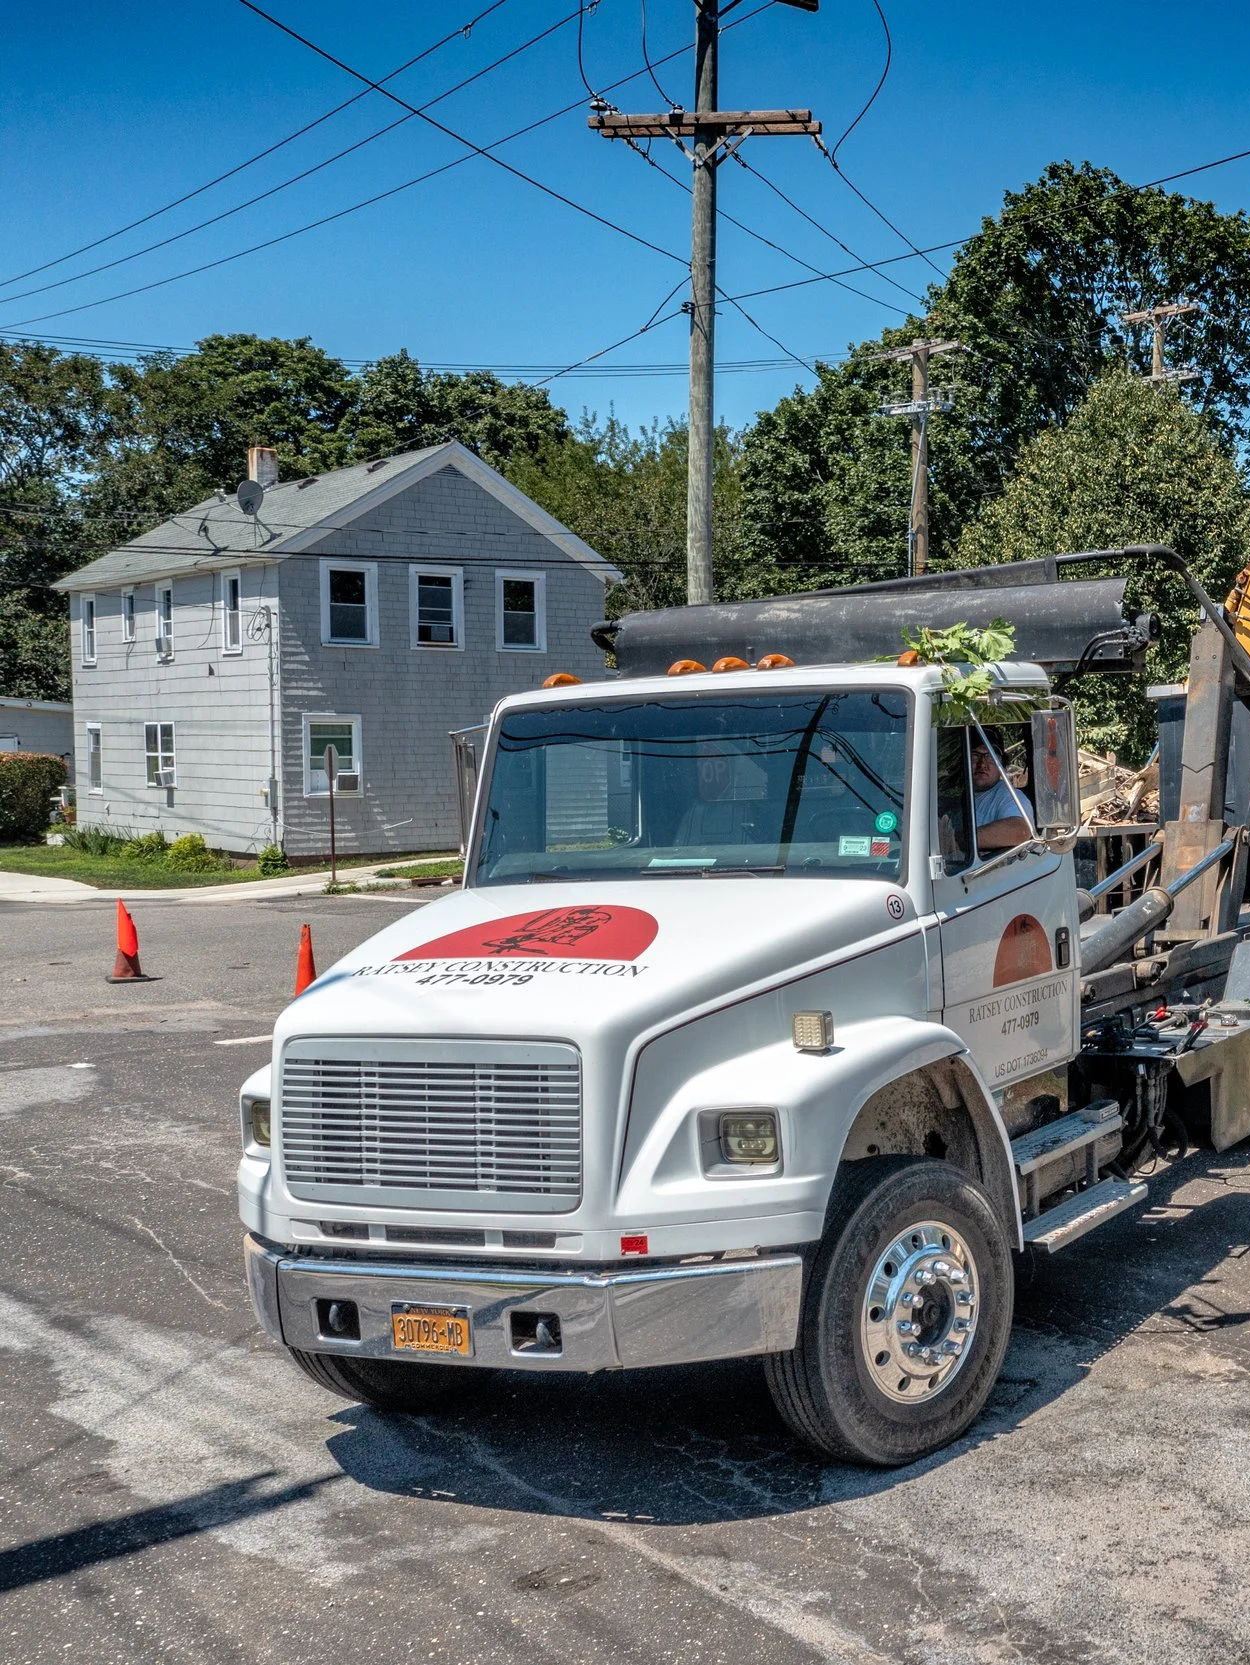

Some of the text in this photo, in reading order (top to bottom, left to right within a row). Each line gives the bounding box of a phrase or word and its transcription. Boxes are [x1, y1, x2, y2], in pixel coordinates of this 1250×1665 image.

[889, 900, 902, 914] 13
[352, 960, 651, 978] RATSEY CONSTRUCTION
[414, 973, 535, 986] 477-0979
[968, 980, 1068, 1024] RATSEY CONSTRUCTION
[1001, 1011, 1040, 1036] 477-0979
[994, 1063, 1006, 1078] US
[1006, 1057, 1022, 1074] DOT
[410, 1307, 451, 1316] NEW YORK
